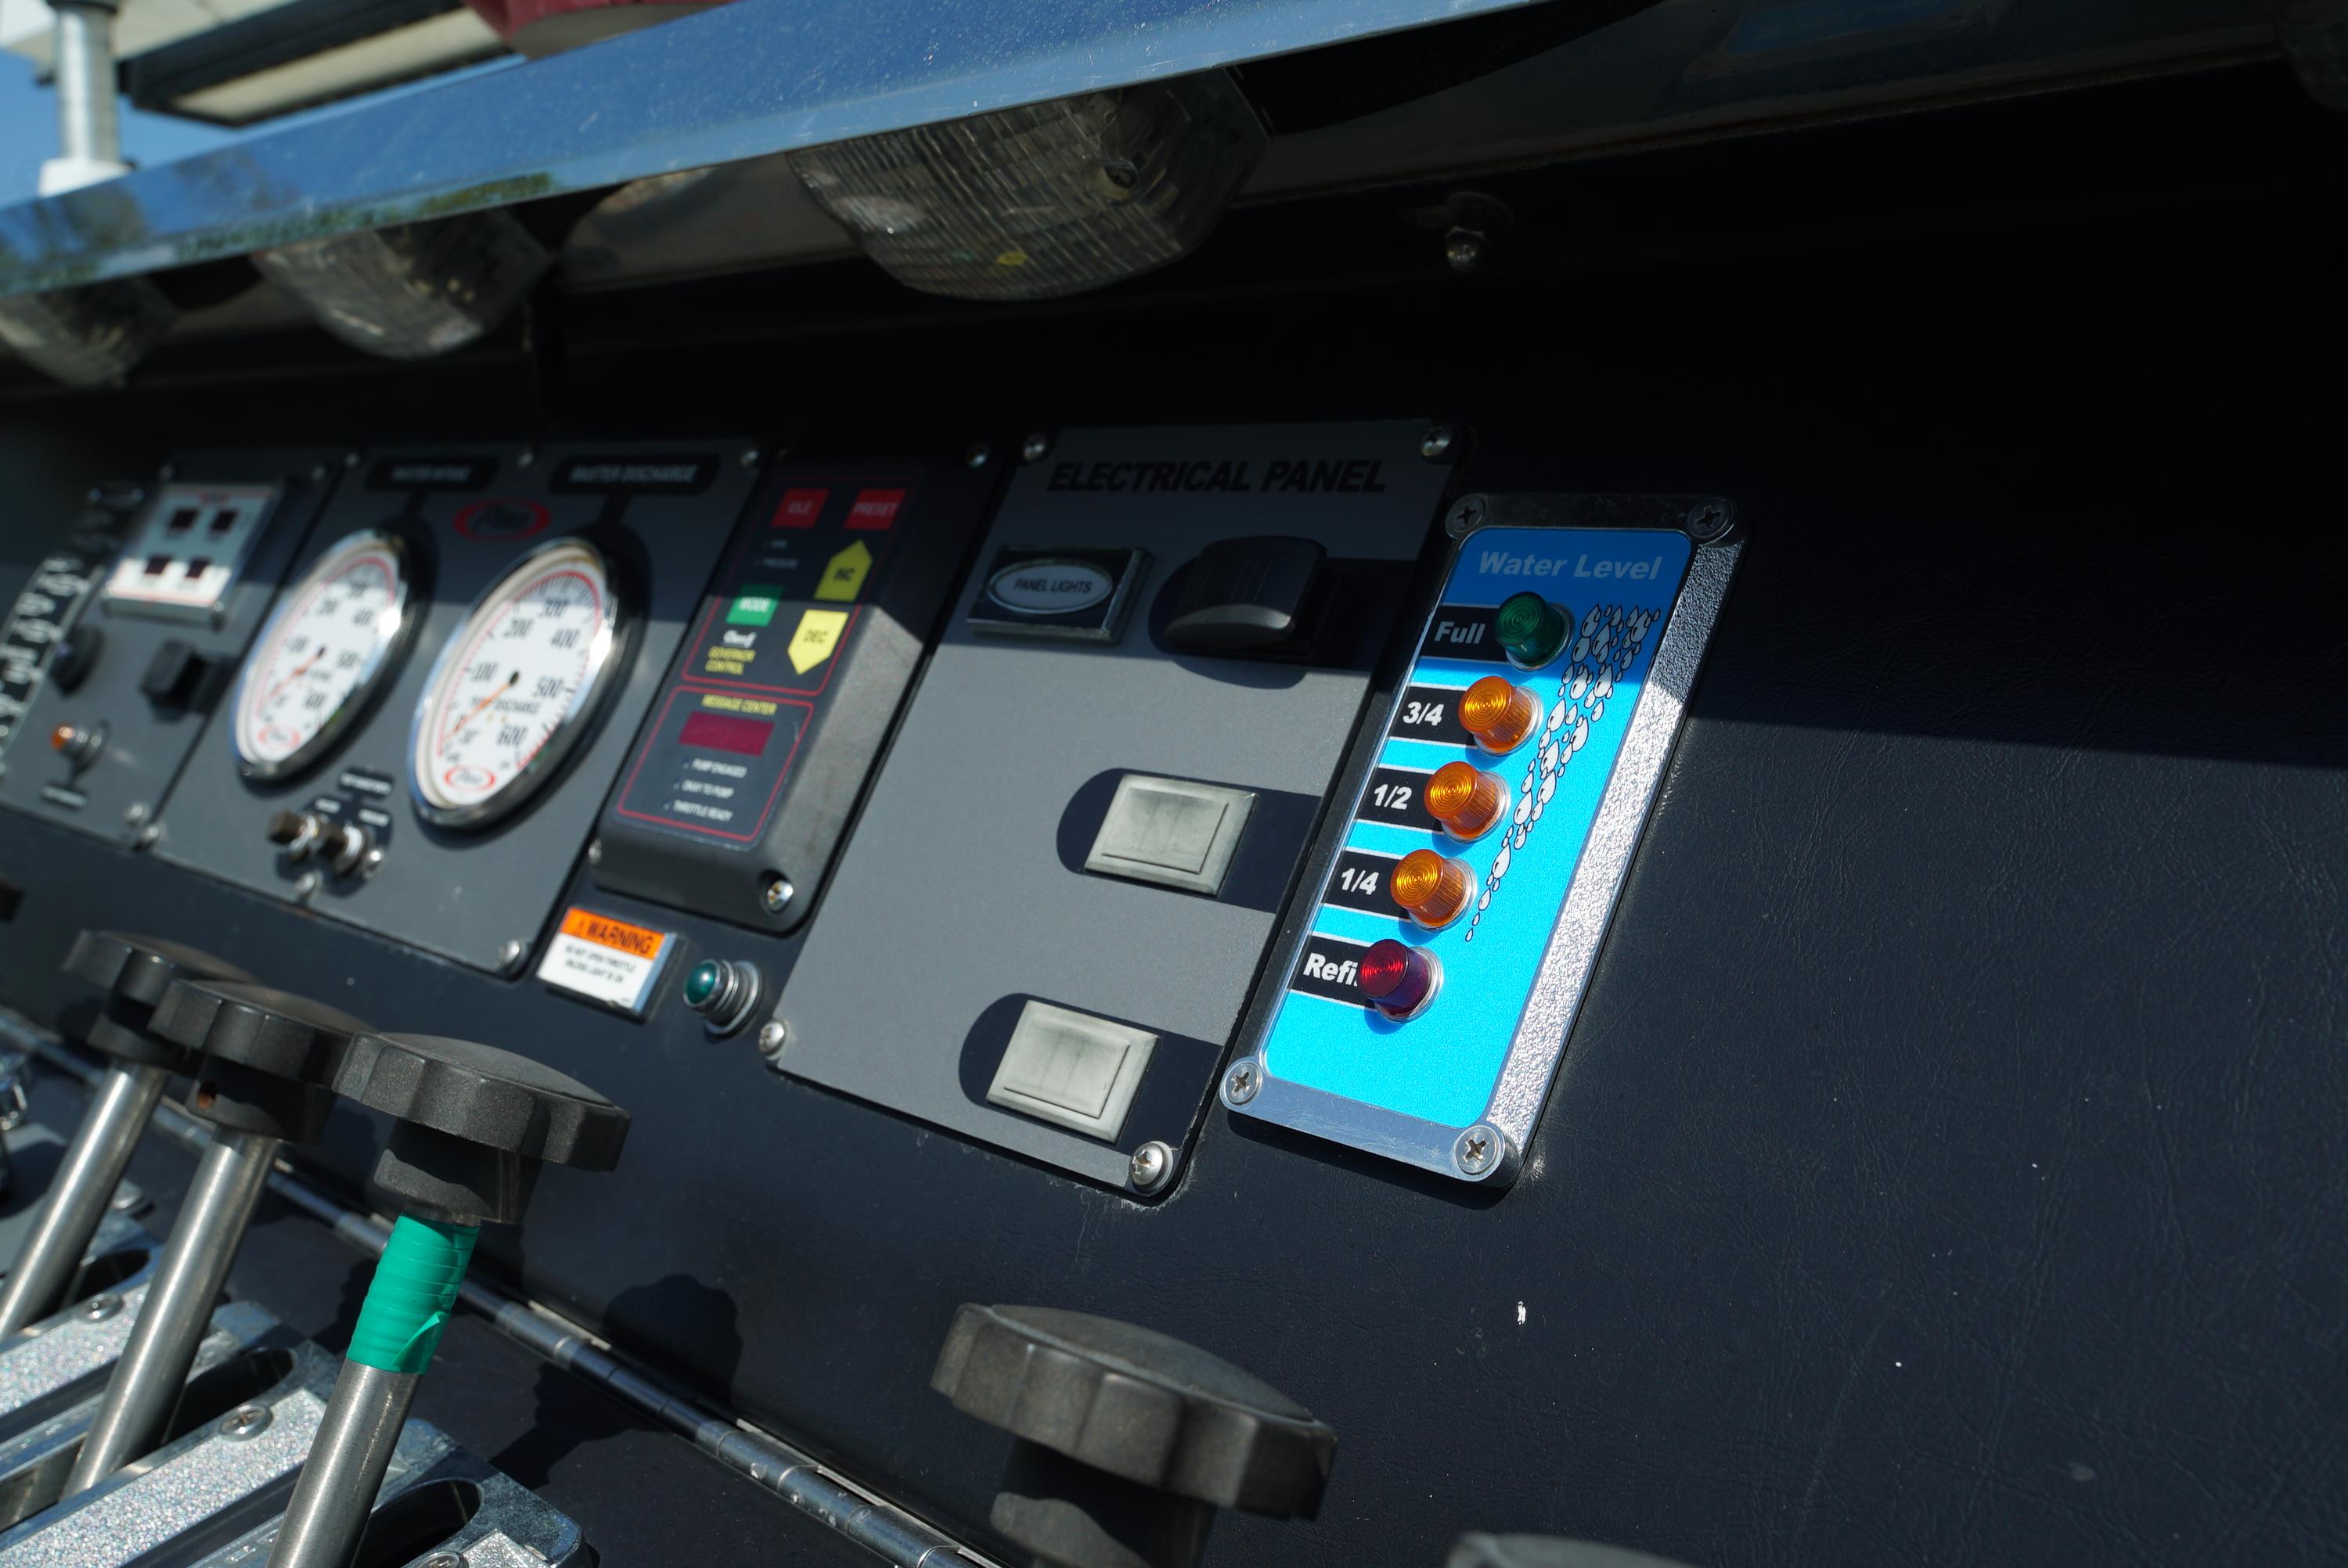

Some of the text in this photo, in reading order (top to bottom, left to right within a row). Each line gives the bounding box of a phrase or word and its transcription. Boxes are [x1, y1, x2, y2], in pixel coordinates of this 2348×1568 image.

[1047, 459, 1387, 493] ELECTRICAL PANEL
[852, 501, 901, 517] PRESET
[1478, 551, 1662, 581] Water Level
[1014, 576, 1093, 595] PANEL LIGHTS
[738, 596, 774, 613] MODE
[1435, 621, 1486, 645] Full
[708, 646, 756, 663] GOVERNOR
[705, 659, 744, 675] CONTROL
[701, 694, 777, 716] MESSAGE CENTER
[1402, 701, 1442, 727] 3/4
[1373, 783, 1413, 811] 1/2
[1340, 868, 1377, 895] 1/4
[588, 920, 655, 955] WARNING
